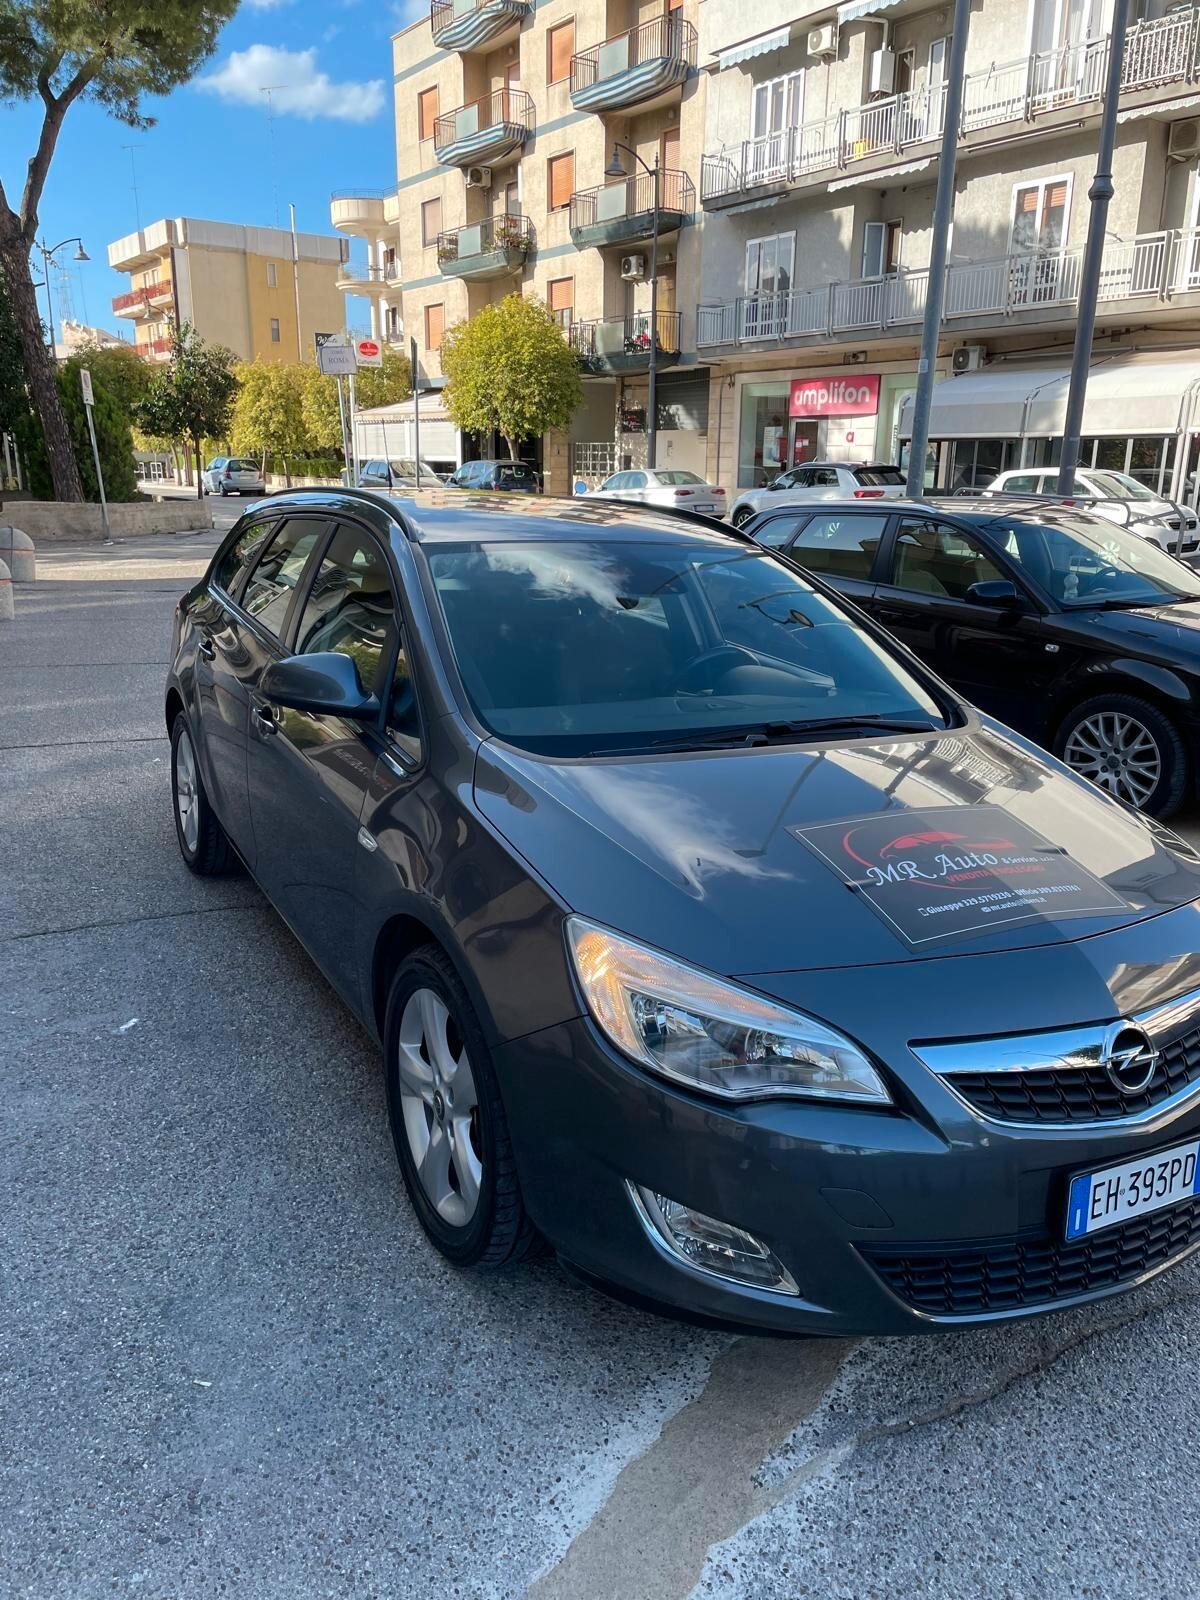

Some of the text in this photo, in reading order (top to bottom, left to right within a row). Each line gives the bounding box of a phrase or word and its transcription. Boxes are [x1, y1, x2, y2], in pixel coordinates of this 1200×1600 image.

[794, 381, 870, 410] amplifon
[866, 860, 937, 886] MR
[934, 852, 998, 876] Auto
[945, 867, 990, 883] VENDITA
[926, 902, 964, 914] Giuseppe
